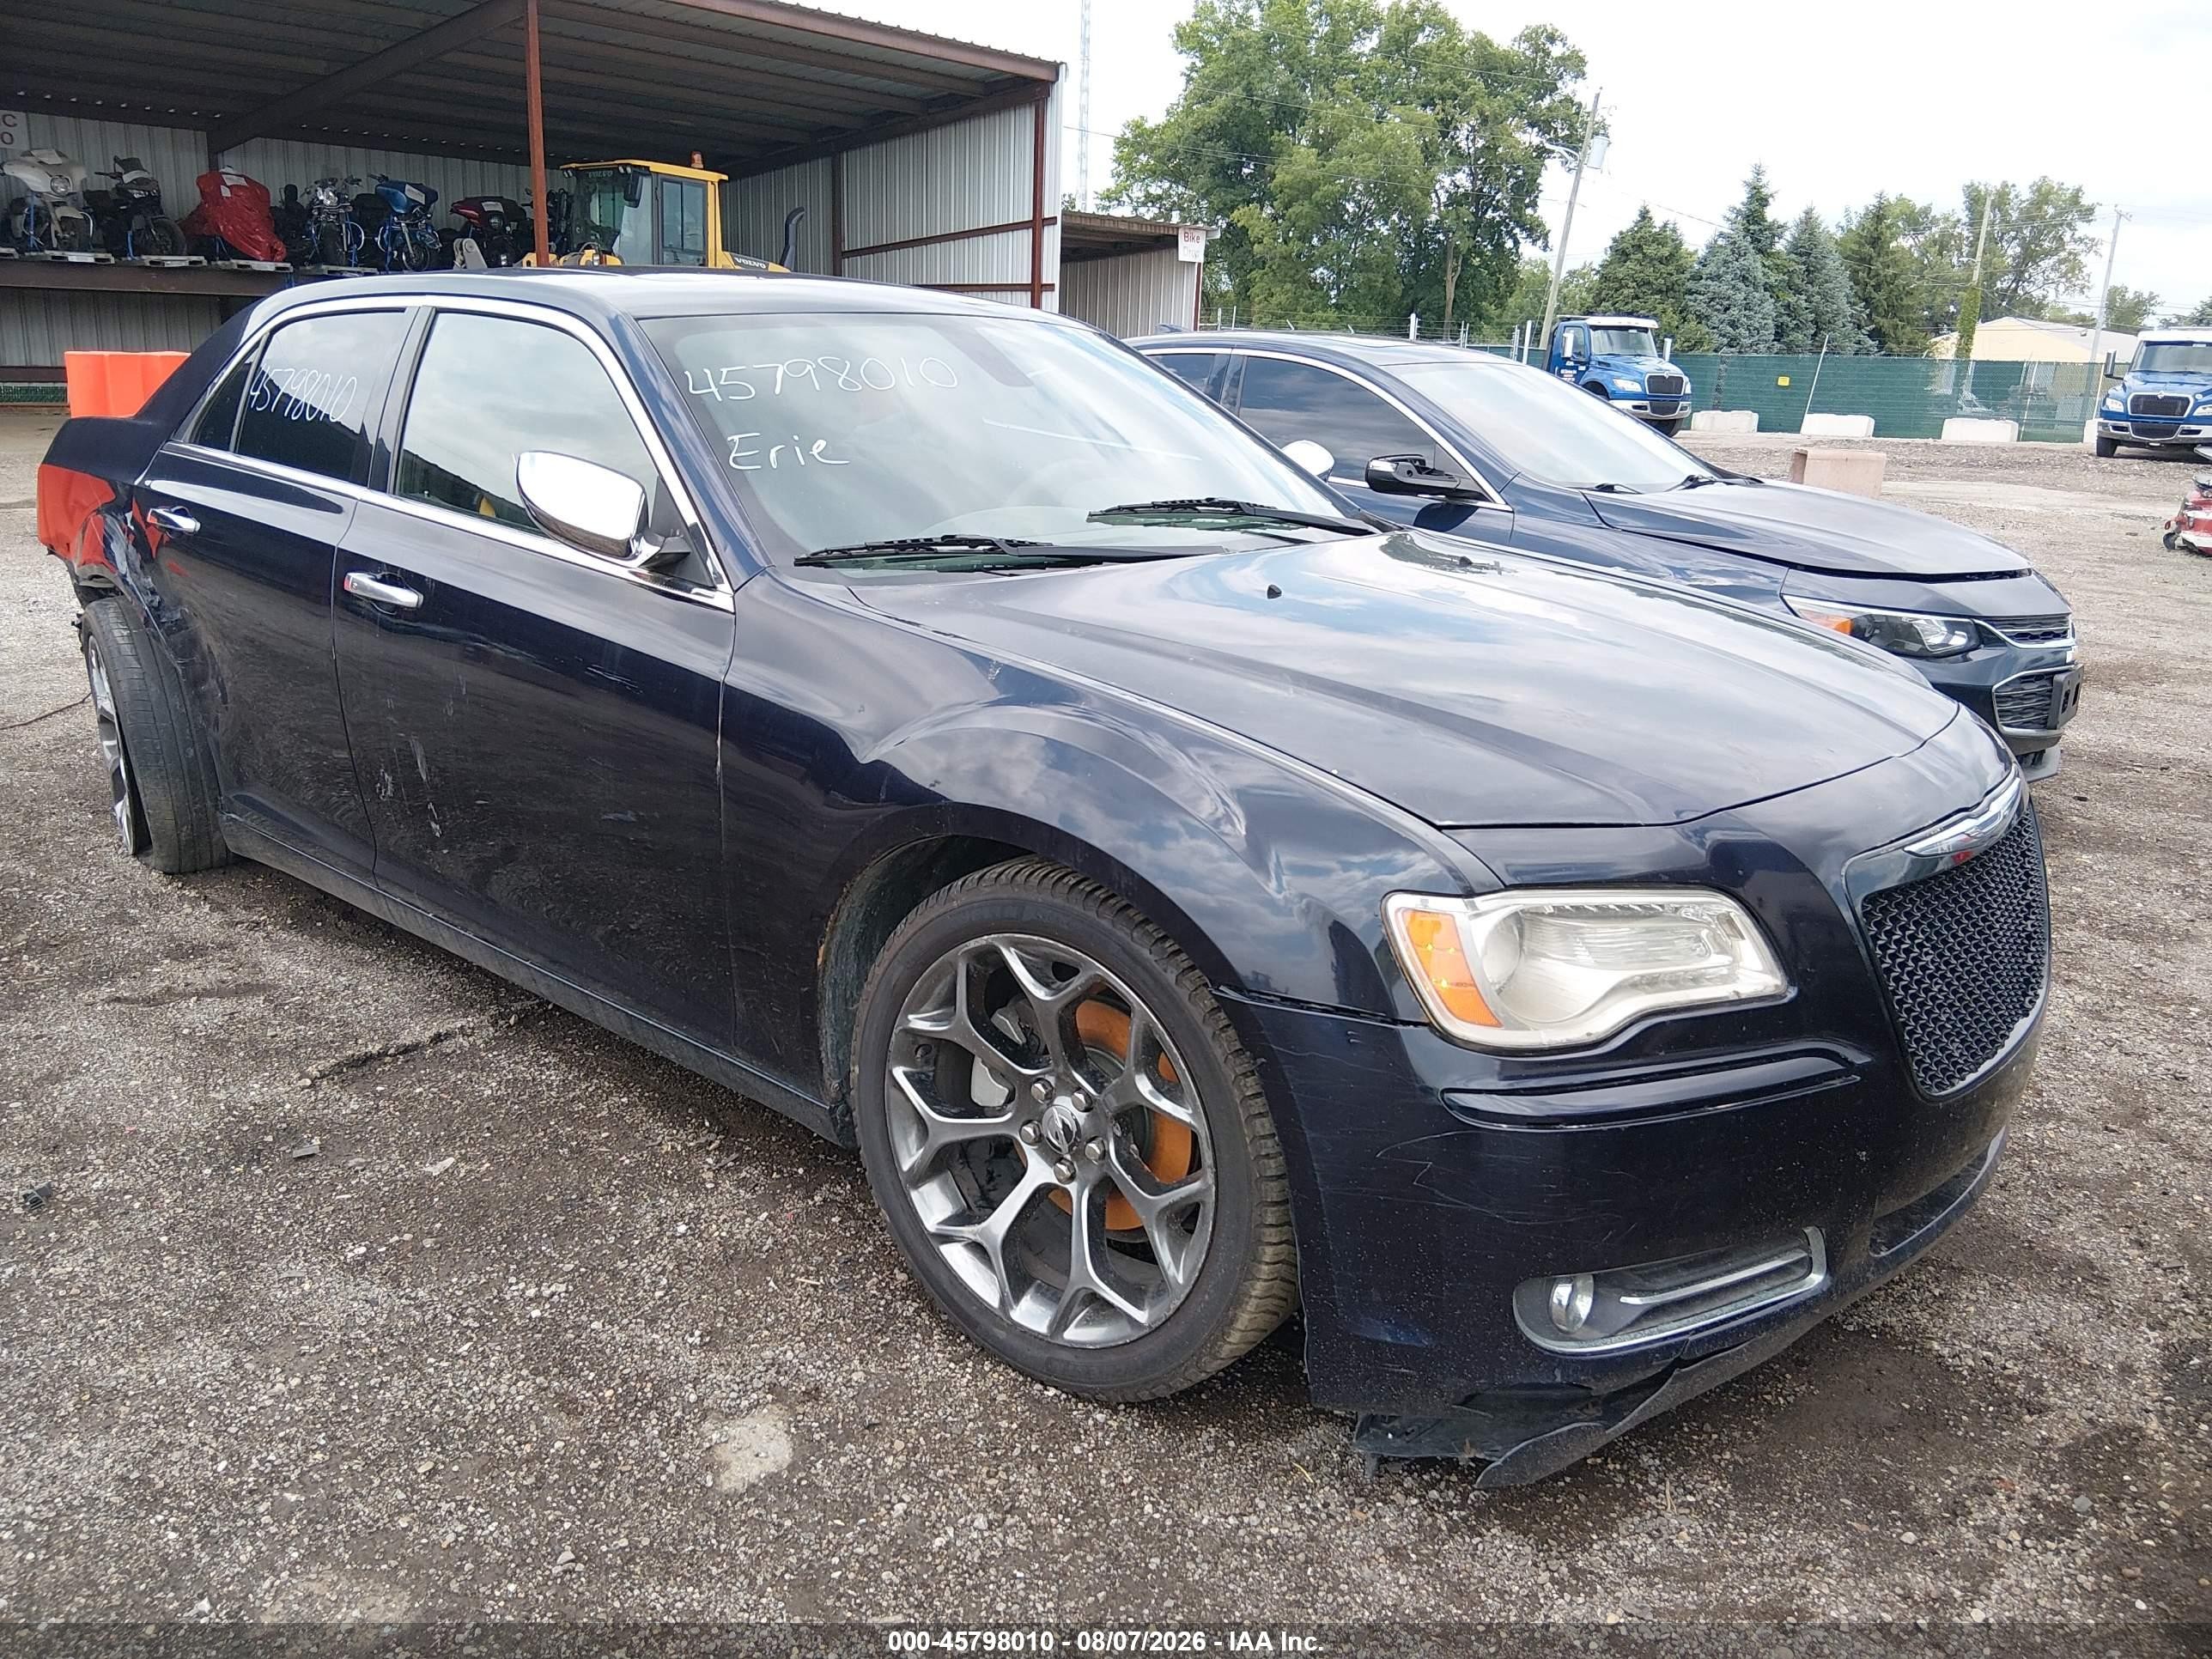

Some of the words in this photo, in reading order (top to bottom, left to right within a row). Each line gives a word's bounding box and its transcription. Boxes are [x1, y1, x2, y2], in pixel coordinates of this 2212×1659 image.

[1184, 232, 1200, 244] Bike
[734, 257, 766, 270] VOLVO
[250, 363, 357, 422] 45798010
[684, 356, 958, 401] 45798010
[727, 432, 850, 469] Erie
